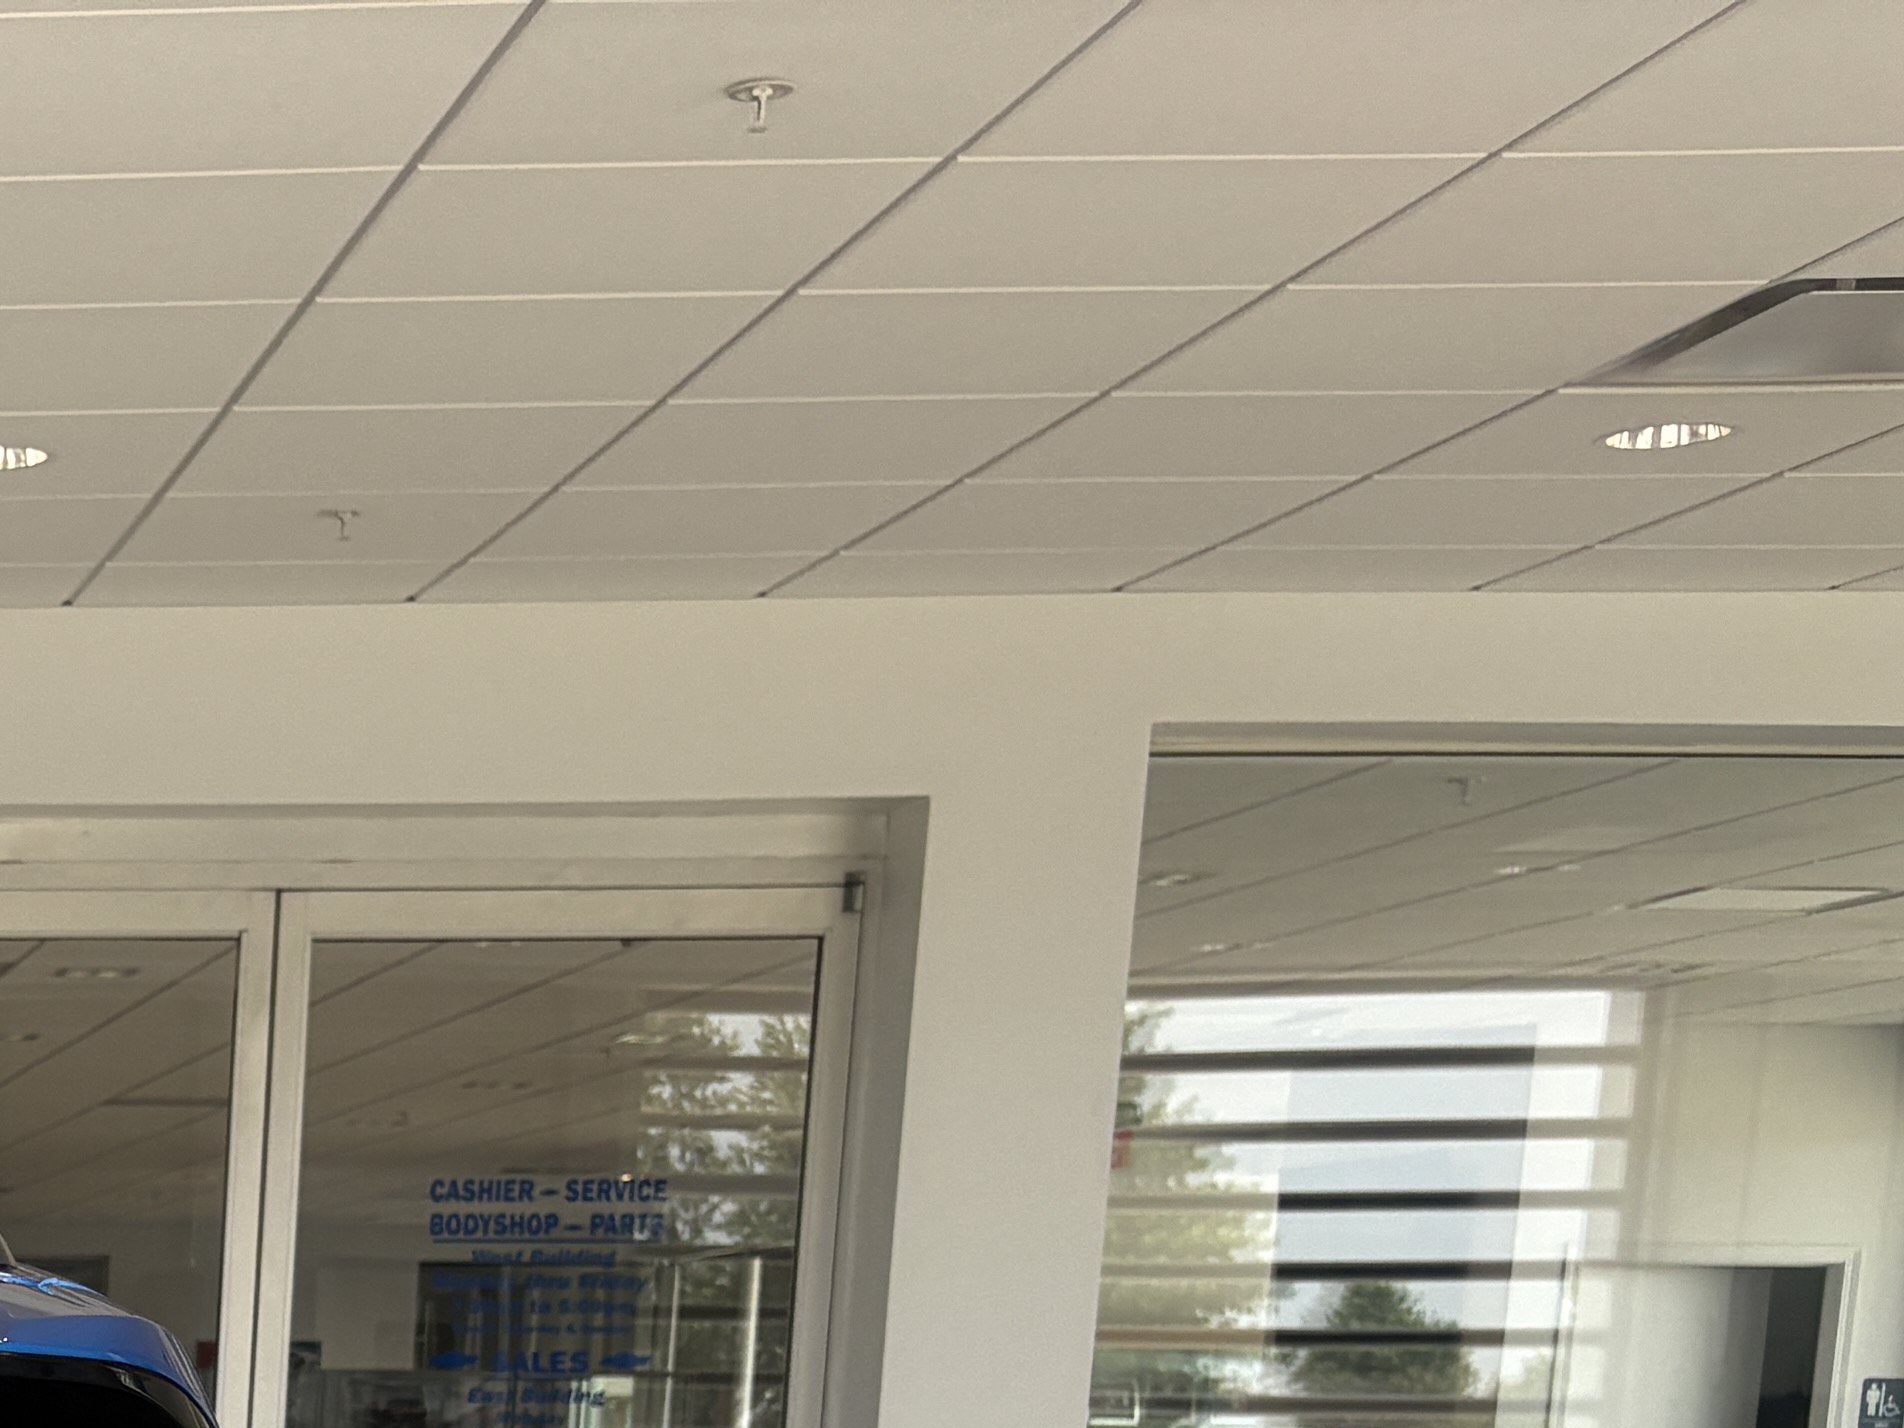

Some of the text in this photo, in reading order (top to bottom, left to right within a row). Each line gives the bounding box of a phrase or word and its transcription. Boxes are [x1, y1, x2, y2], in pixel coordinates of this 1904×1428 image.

[429, 1179, 535, 1203] CASHIER
[564, 1178, 669, 1203] SERVICE
[429, 1212, 560, 1237] BODYSHOP
[589, 1212, 665, 1238] PARTS
[495, 1351, 590, 1374] SALES
